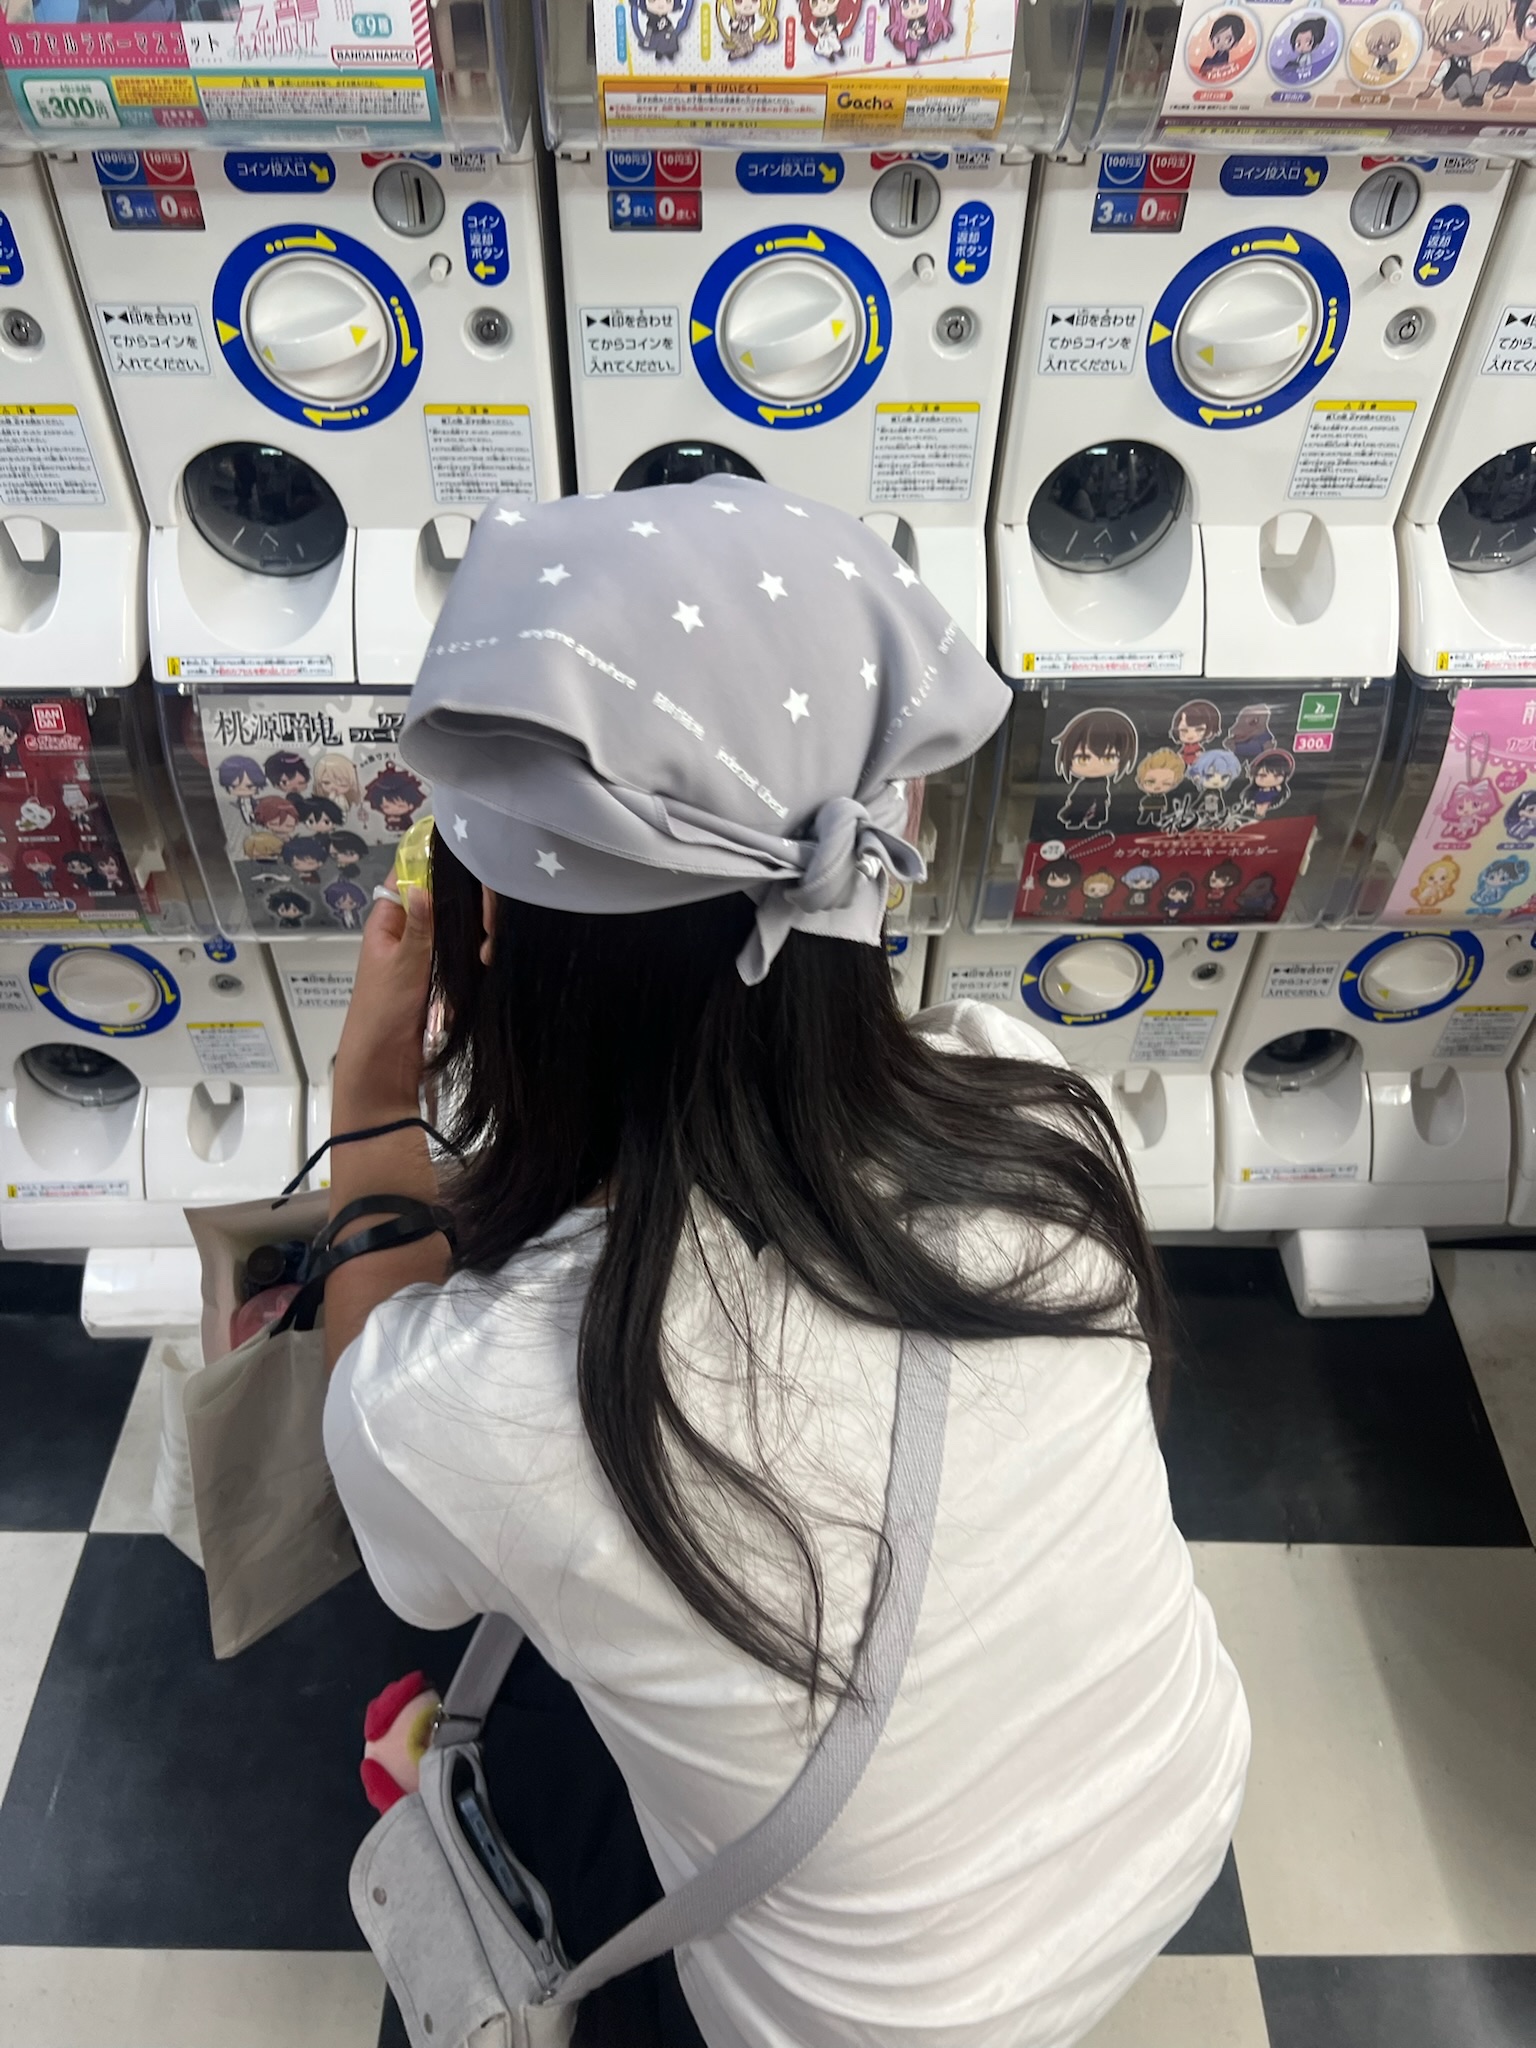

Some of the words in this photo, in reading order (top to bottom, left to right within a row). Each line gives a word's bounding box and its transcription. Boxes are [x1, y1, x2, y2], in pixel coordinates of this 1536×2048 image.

[9, 31, 219, 56] カプセルラバーマスコット
[337, 51, 374, 61] BANDAI
[376, 51, 414, 61] NAMCO
[837, 92, 894, 111] Gacha
[237, 161, 308, 177] コイン投入口
[748, 161, 817, 177] コイン投入口
[1232, 165, 1302, 180] コイン投入口
[467, 215, 500, 229] コイン
[958, 214, 990, 227] コイン
[1432, 218, 1465, 231] コイン
[472, 247, 504, 260] ボタン
[955, 245, 988, 258] ボタン
[1422, 248, 1455, 261] ボタン
[110, 334, 198, 349] てからコインを
[588, 337, 673, 351] てからコインを
[1048, 337, 1131, 350] てからコインを
[1499, 337, 1536, 350] てから
[118, 357, 204, 371] 入れてください。
[590, 359, 676, 373] 入れてください。
[1043, 358, 1127, 372] 入れてください。
[214, 710, 343, 747] 桃源暗鬼
[1113, 846, 1279, 859] カプセルラバーキーホルダー
